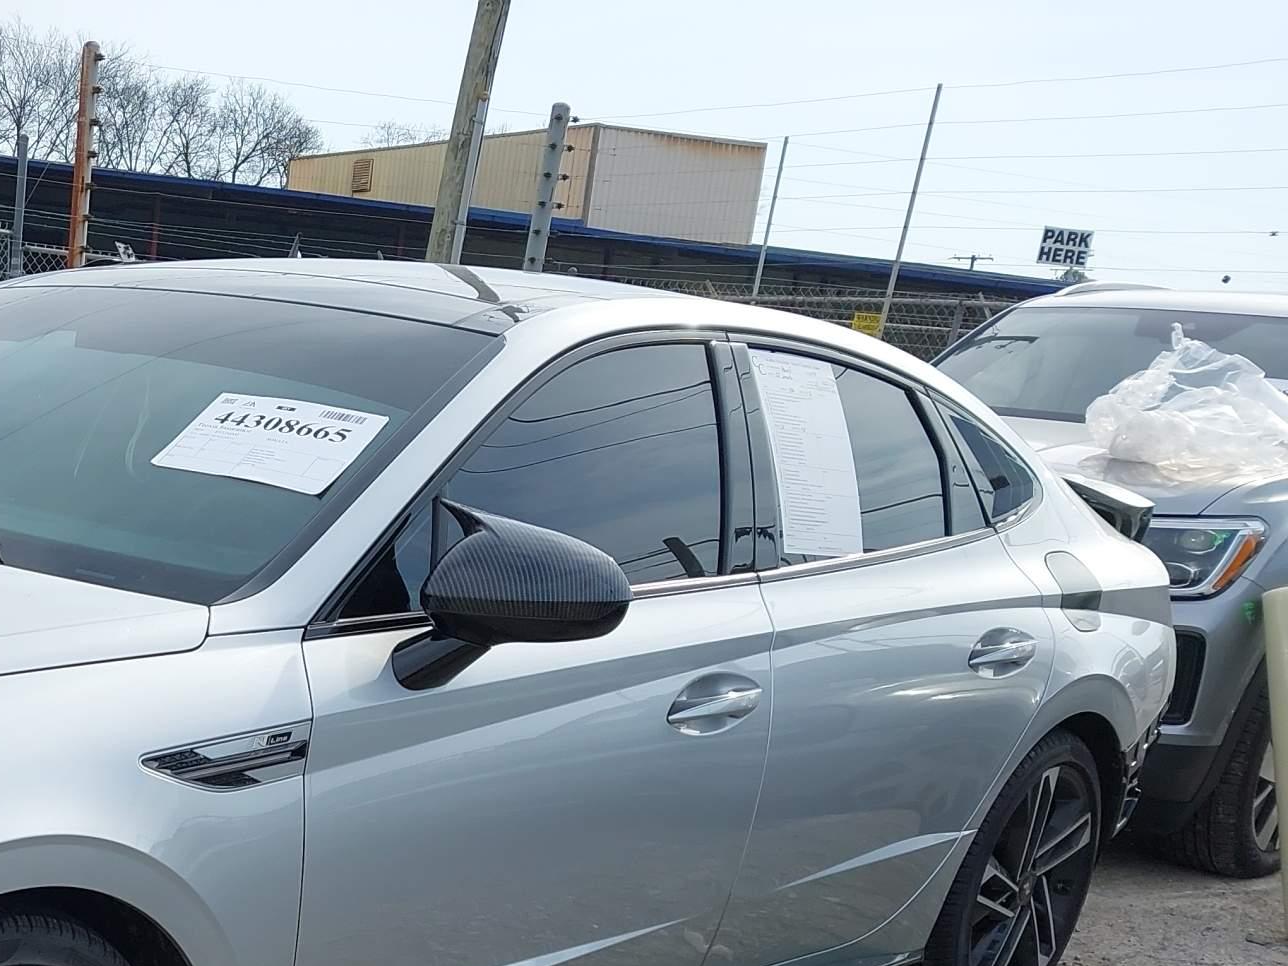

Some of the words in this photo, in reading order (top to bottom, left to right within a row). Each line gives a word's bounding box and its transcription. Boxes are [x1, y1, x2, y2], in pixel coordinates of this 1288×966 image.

[1042, 229, 1092, 249] PARK
[1038, 246, 1088, 266] HERE
[214, 411, 352, 443] 44308665
